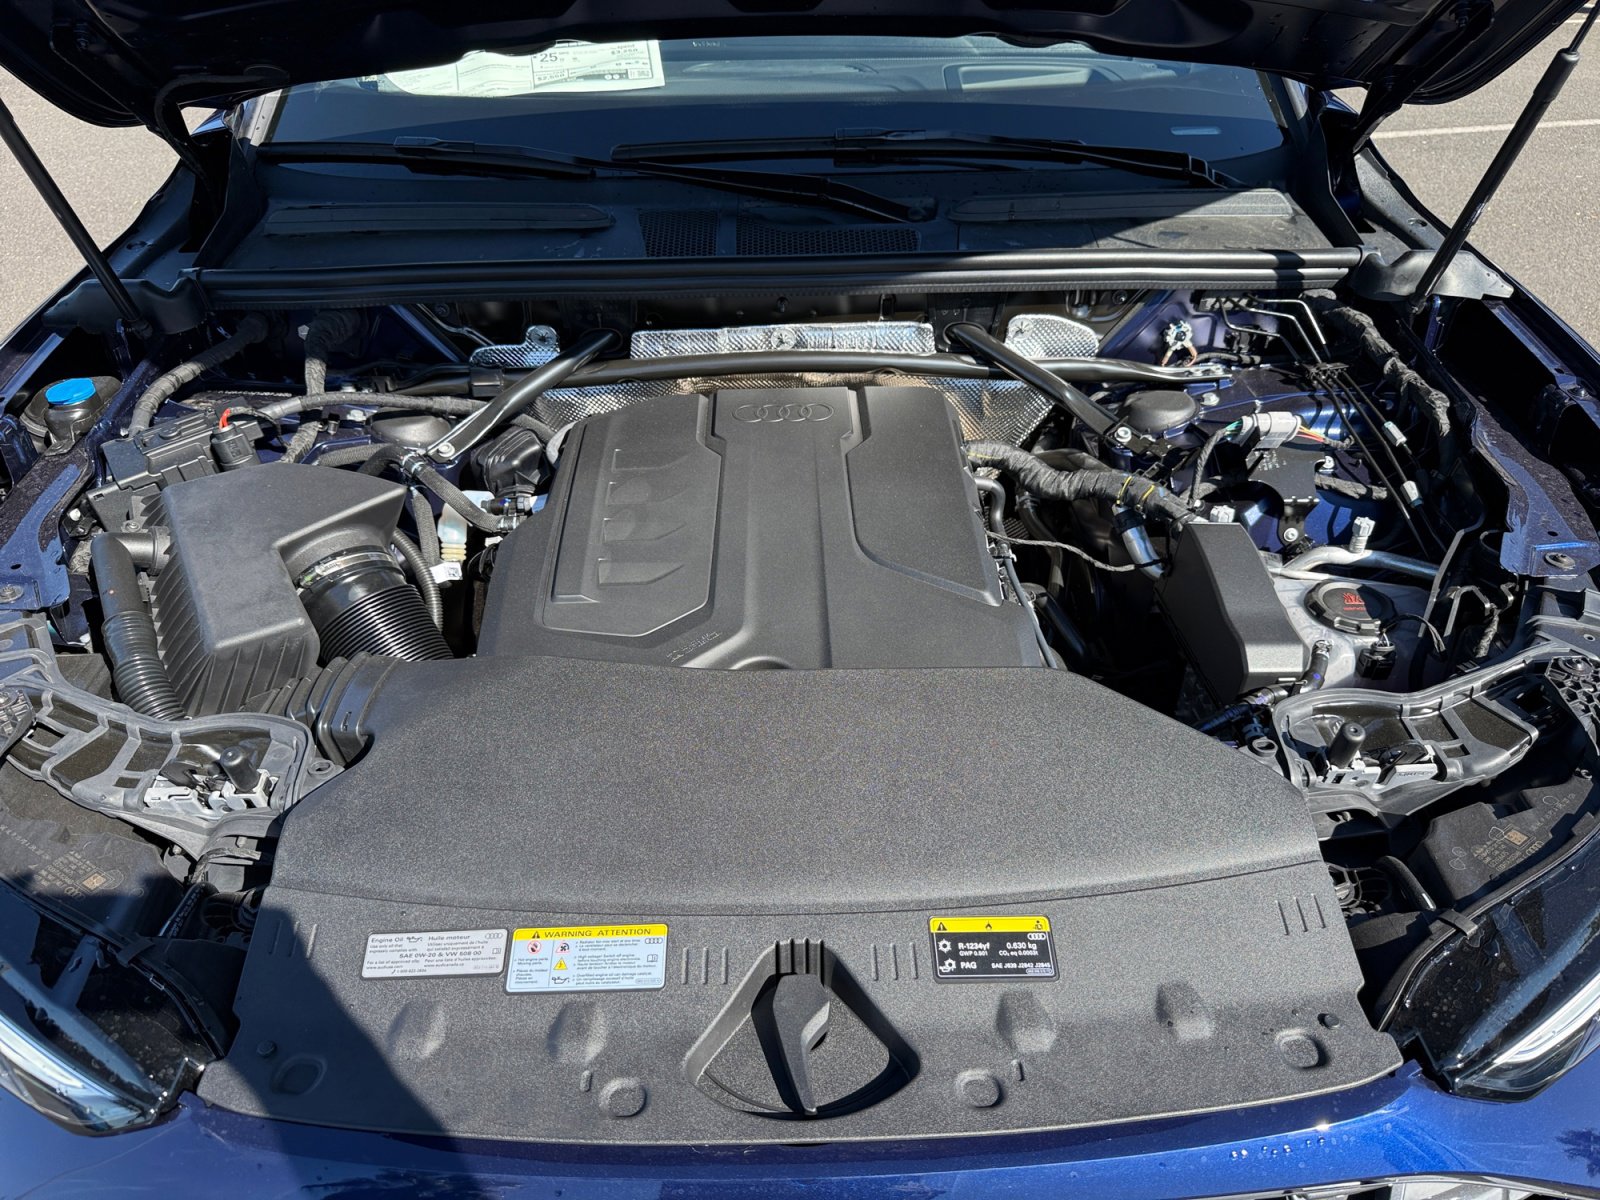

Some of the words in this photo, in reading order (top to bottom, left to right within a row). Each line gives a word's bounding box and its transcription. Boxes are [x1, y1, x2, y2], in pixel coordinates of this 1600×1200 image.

[540, 53, 558, 63] 25
[544, 930, 592, 938] WARNING
[597, 928, 651, 936] ATTENTION
[958, 942, 990, 951] R-1234yf
[1027, 941, 1038, 951] kg
[960, 961, 977, 969] PAG
